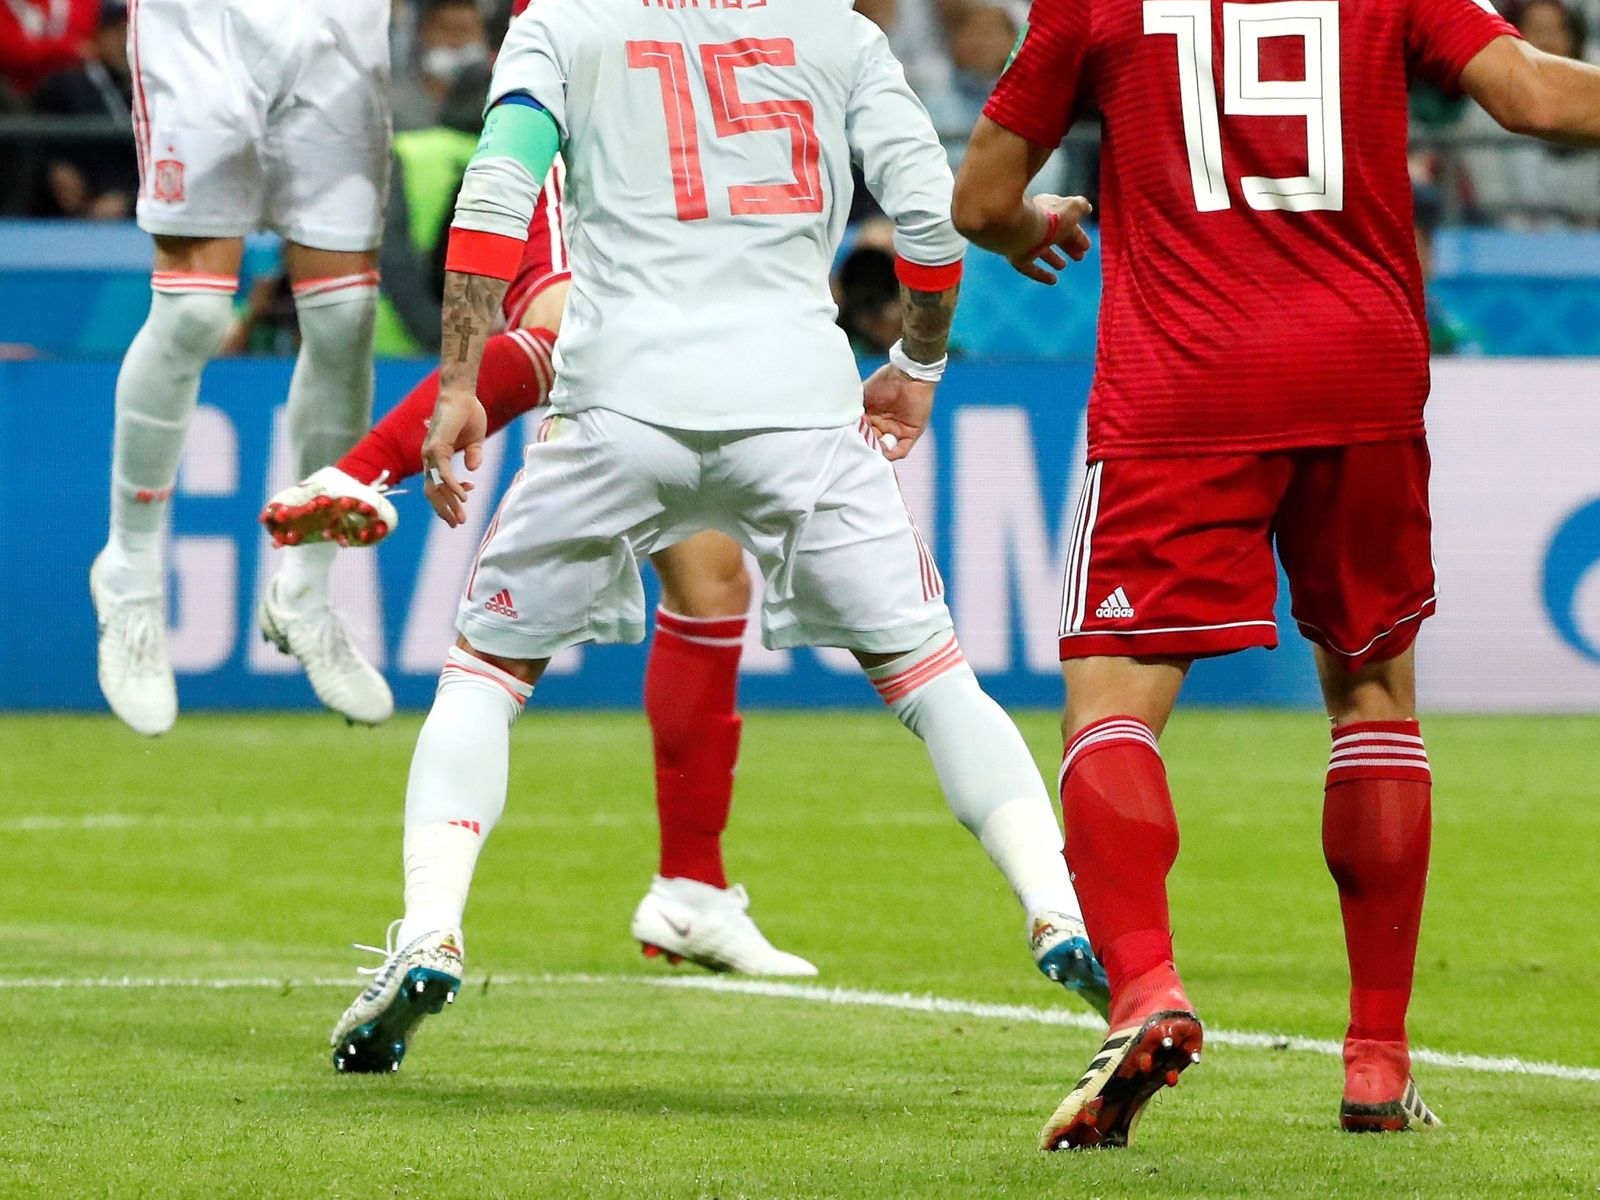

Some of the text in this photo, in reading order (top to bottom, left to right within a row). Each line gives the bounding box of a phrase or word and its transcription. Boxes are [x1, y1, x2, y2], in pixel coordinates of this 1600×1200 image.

[624, 37, 824, 222] 15
[485, 601, 519, 619] adidas
[1095, 606, 1135, 618] adidas
